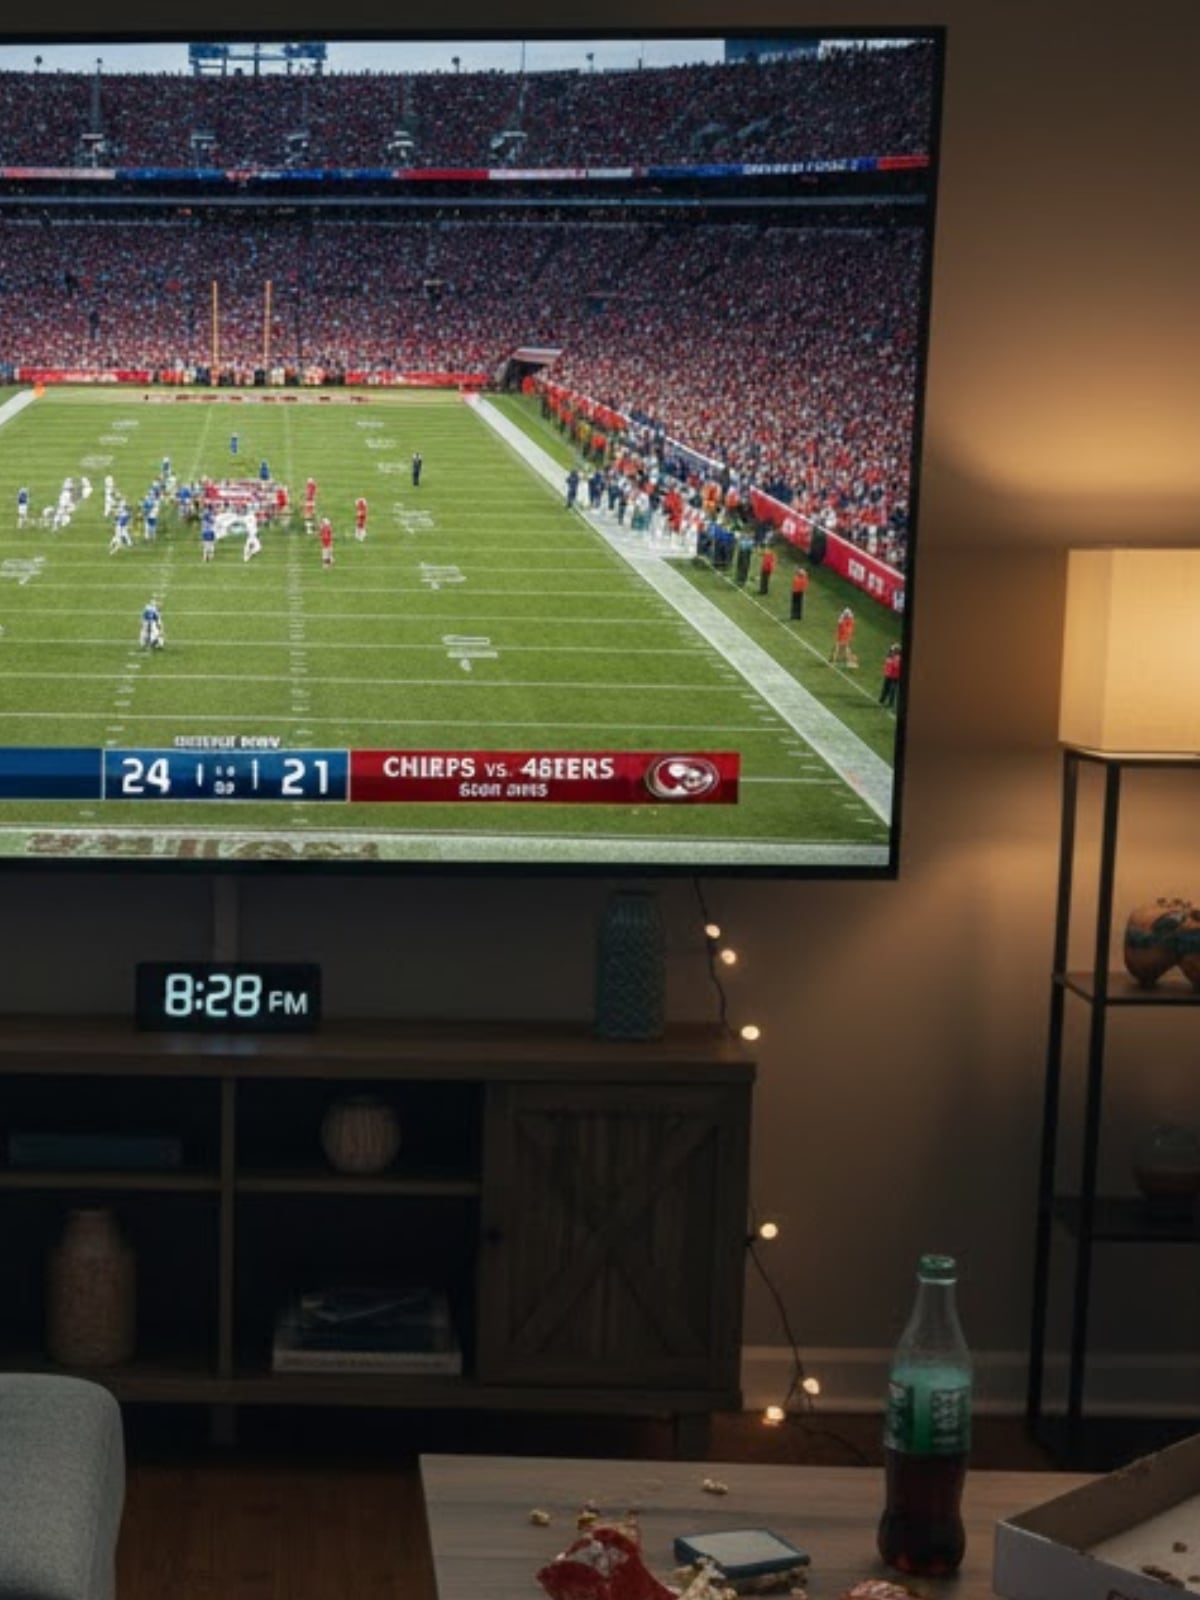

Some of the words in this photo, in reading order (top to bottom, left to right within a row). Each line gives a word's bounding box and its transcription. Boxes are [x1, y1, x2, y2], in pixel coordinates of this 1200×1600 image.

[121, 757, 171, 794] 24
[281, 758, 328, 795] 21
[165, 973, 262, 1017] 8:28
